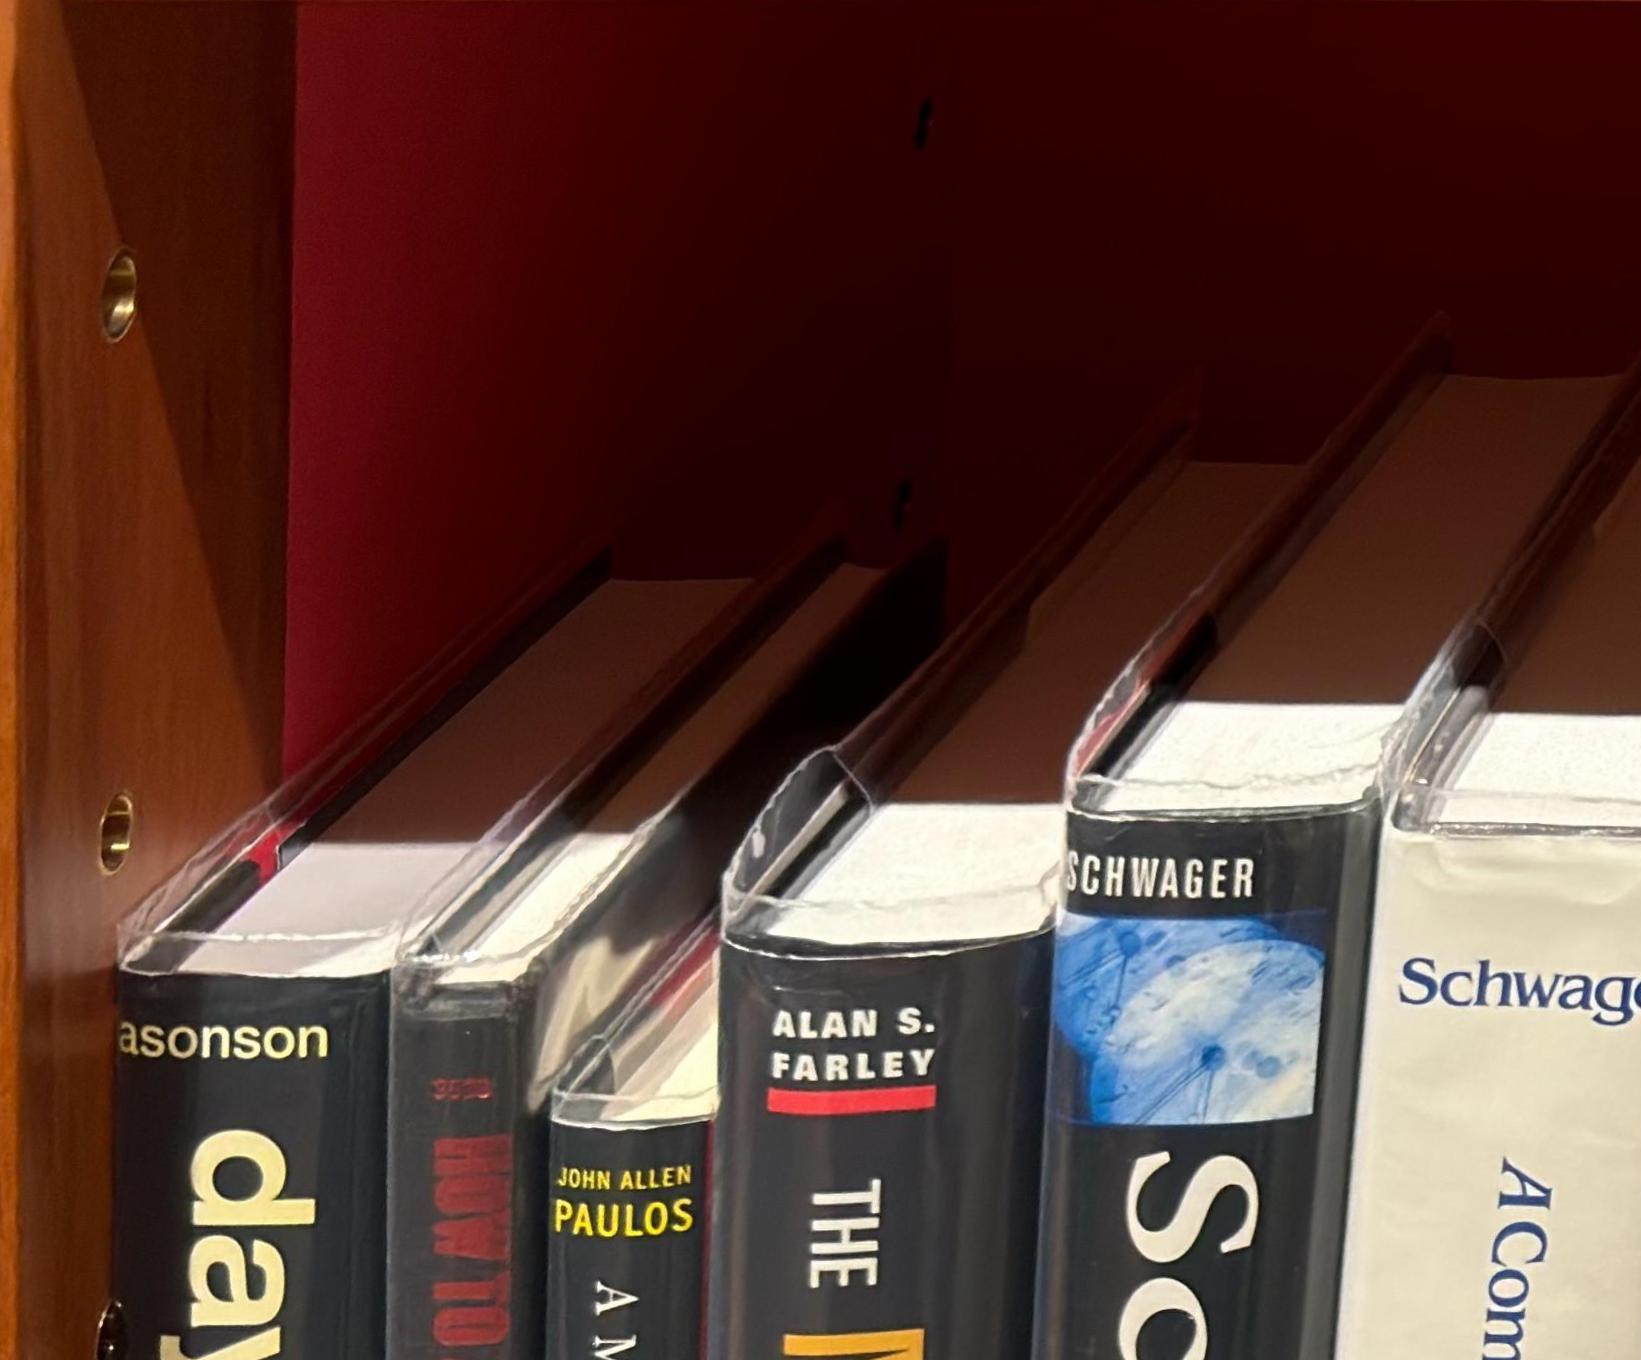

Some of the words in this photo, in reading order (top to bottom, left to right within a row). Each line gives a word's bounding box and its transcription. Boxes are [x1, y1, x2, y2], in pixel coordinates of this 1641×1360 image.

[1067, 856, 1255, 898] SCHWAGER
[774, 1010, 877, 1038] ALAN
[897, 1007, 935, 1035] S.
[772, 1049, 935, 1082] FARLEY
[431, 1133, 512, 1259] HOW
[557, 1166, 611, 1190] JOHN
[619, 1162, 693, 1191] ALLEN
[1496, 1157, 1553, 1210] A
[555, 1199, 693, 1238] PAULOS
[809, 1179, 881, 1288] THE
[429, 1280, 511, 1347] TO
[594, 1283, 639, 1314] A
